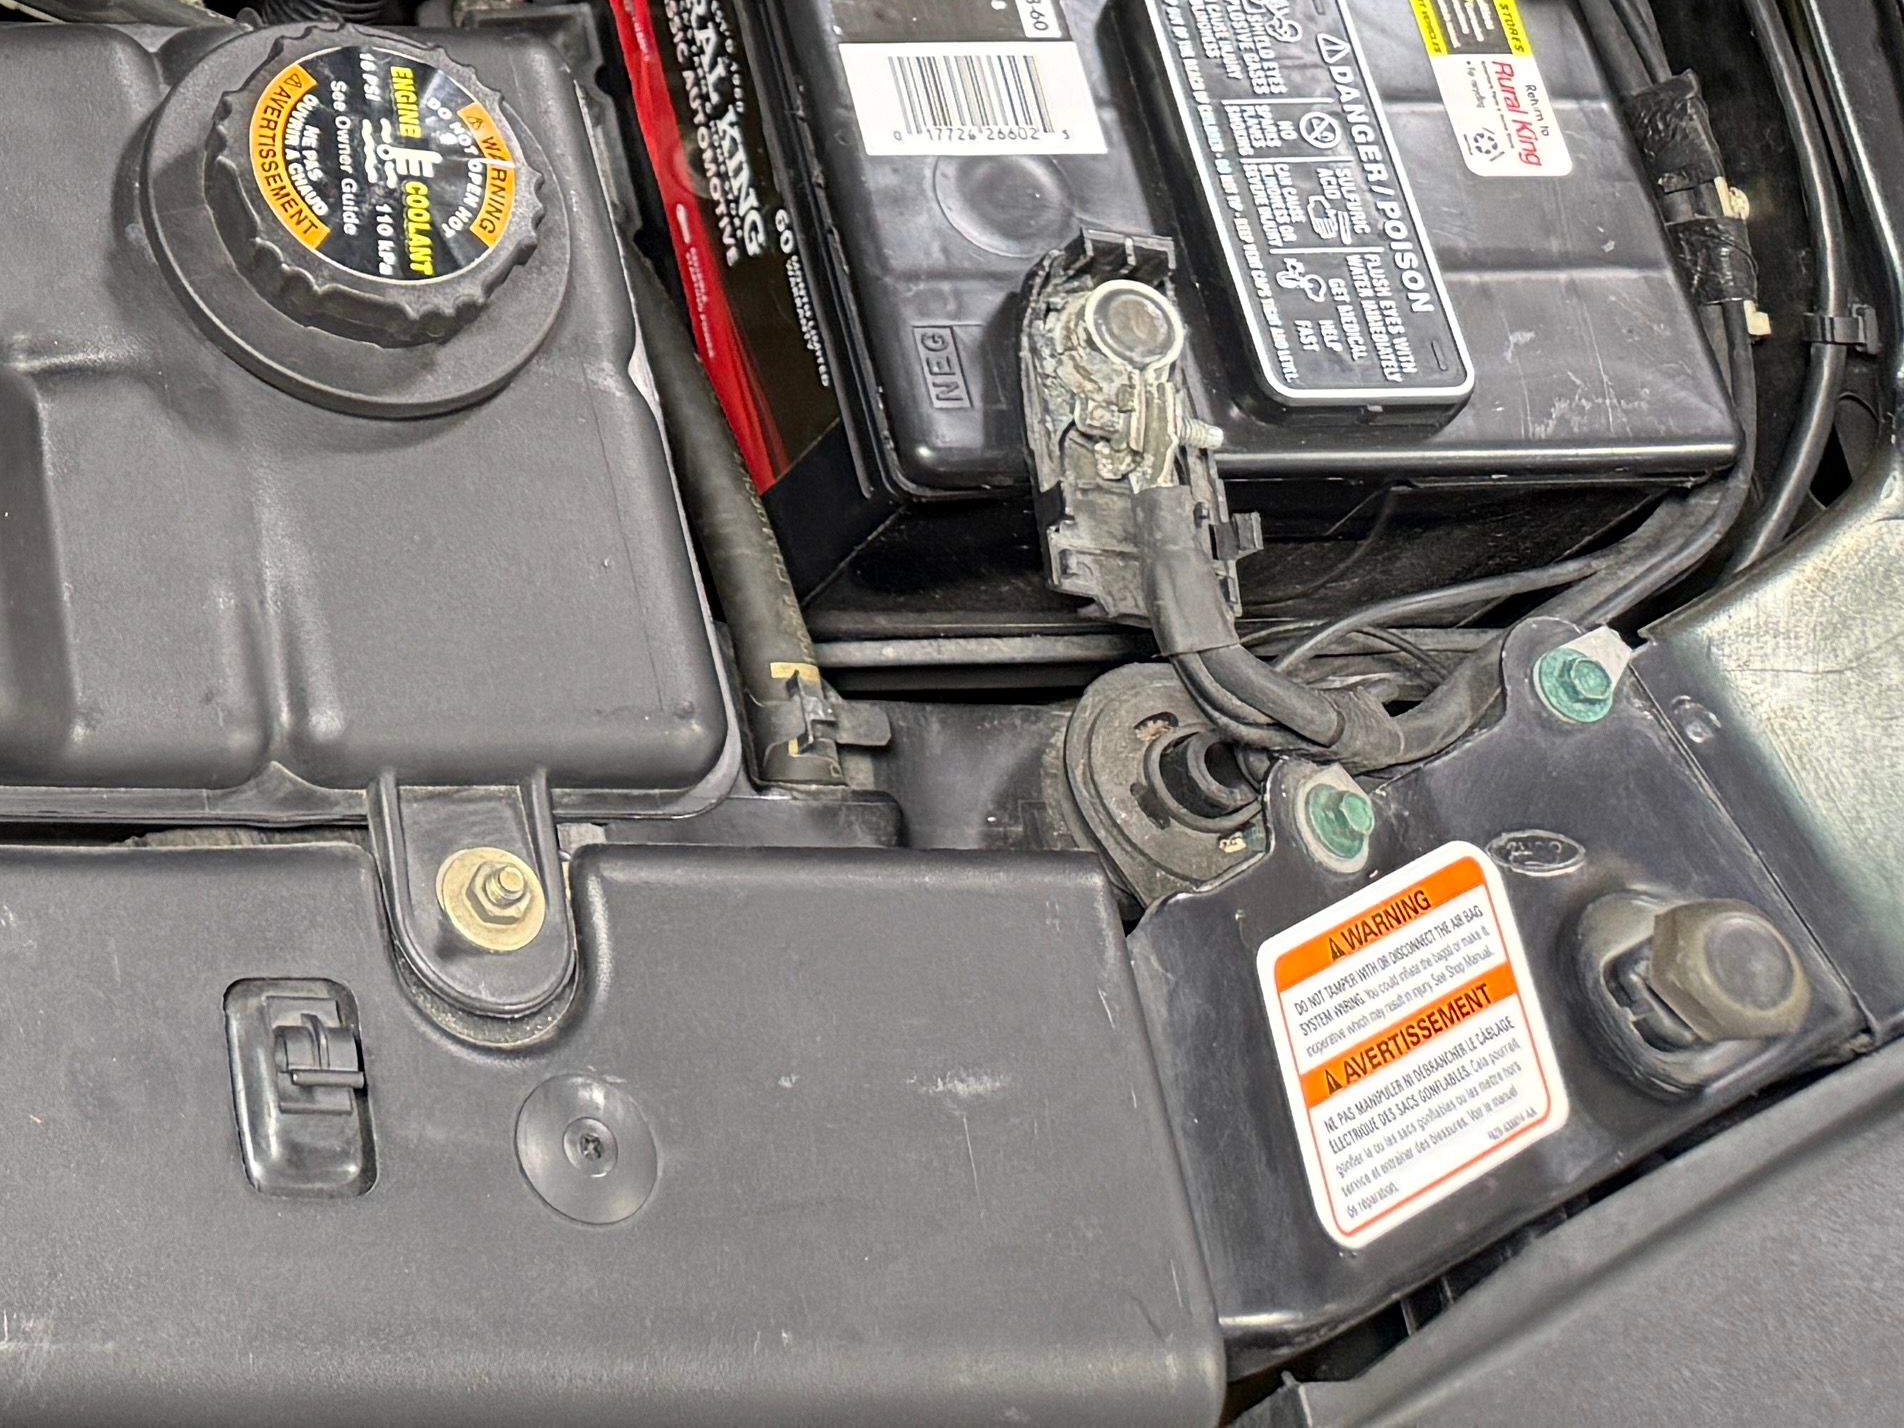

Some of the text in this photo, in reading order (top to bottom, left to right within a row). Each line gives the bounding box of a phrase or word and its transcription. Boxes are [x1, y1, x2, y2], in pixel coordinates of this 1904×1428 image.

[1243, 51, 1272, 96] GASES
[1246, 12, 1289, 95] SHIELD EYES
[301, 124, 325, 183] NE PAS
[1276, 119, 1299, 142] NO
[1491, 60, 1544, 168] Rural King
[257, 85, 320, 236] AVERTISSEMENT
[287, 160, 330, 217] CHAUD
[330, 80, 361, 236] See Owner Guide
[390, 65, 435, 276] ENGINE COOLANT
[425, 96, 485, 239] DO NOT OPEN HOT
[680, 66, 742, 270] AUTOMOTIVE
[712, 104, 768, 259] KING
[1317, 167, 1343, 201] ACID
[1327, 64, 1435, 313] DANGER/POISON
[376, 204, 396, 236] 110
[1334, 167, 1372, 236] SULFURIC
[1346, 254, 1375, 299] WATER
[1364, 253, 1419, 375] FLUSH EYES WITH
[1294, 319, 1321, 353] FAST
[1318, 319, 1343, 353] HELP
[1328, 277, 1369, 363] GET MEDICAL
[1293, 903, 1484, 1017] DO NOT TAMPER WITH DISCONNECT THE AIR BAG
[1341, 889, 1432, 952] WARNING
[1298, 1008, 1335, 1037] SYSTEM
[1340, 981, 1494, 1084] AVERTISSEMENT
[1322, 1038, 1469, 1136] NE PAS MANIPULER DÉBRANCHER
